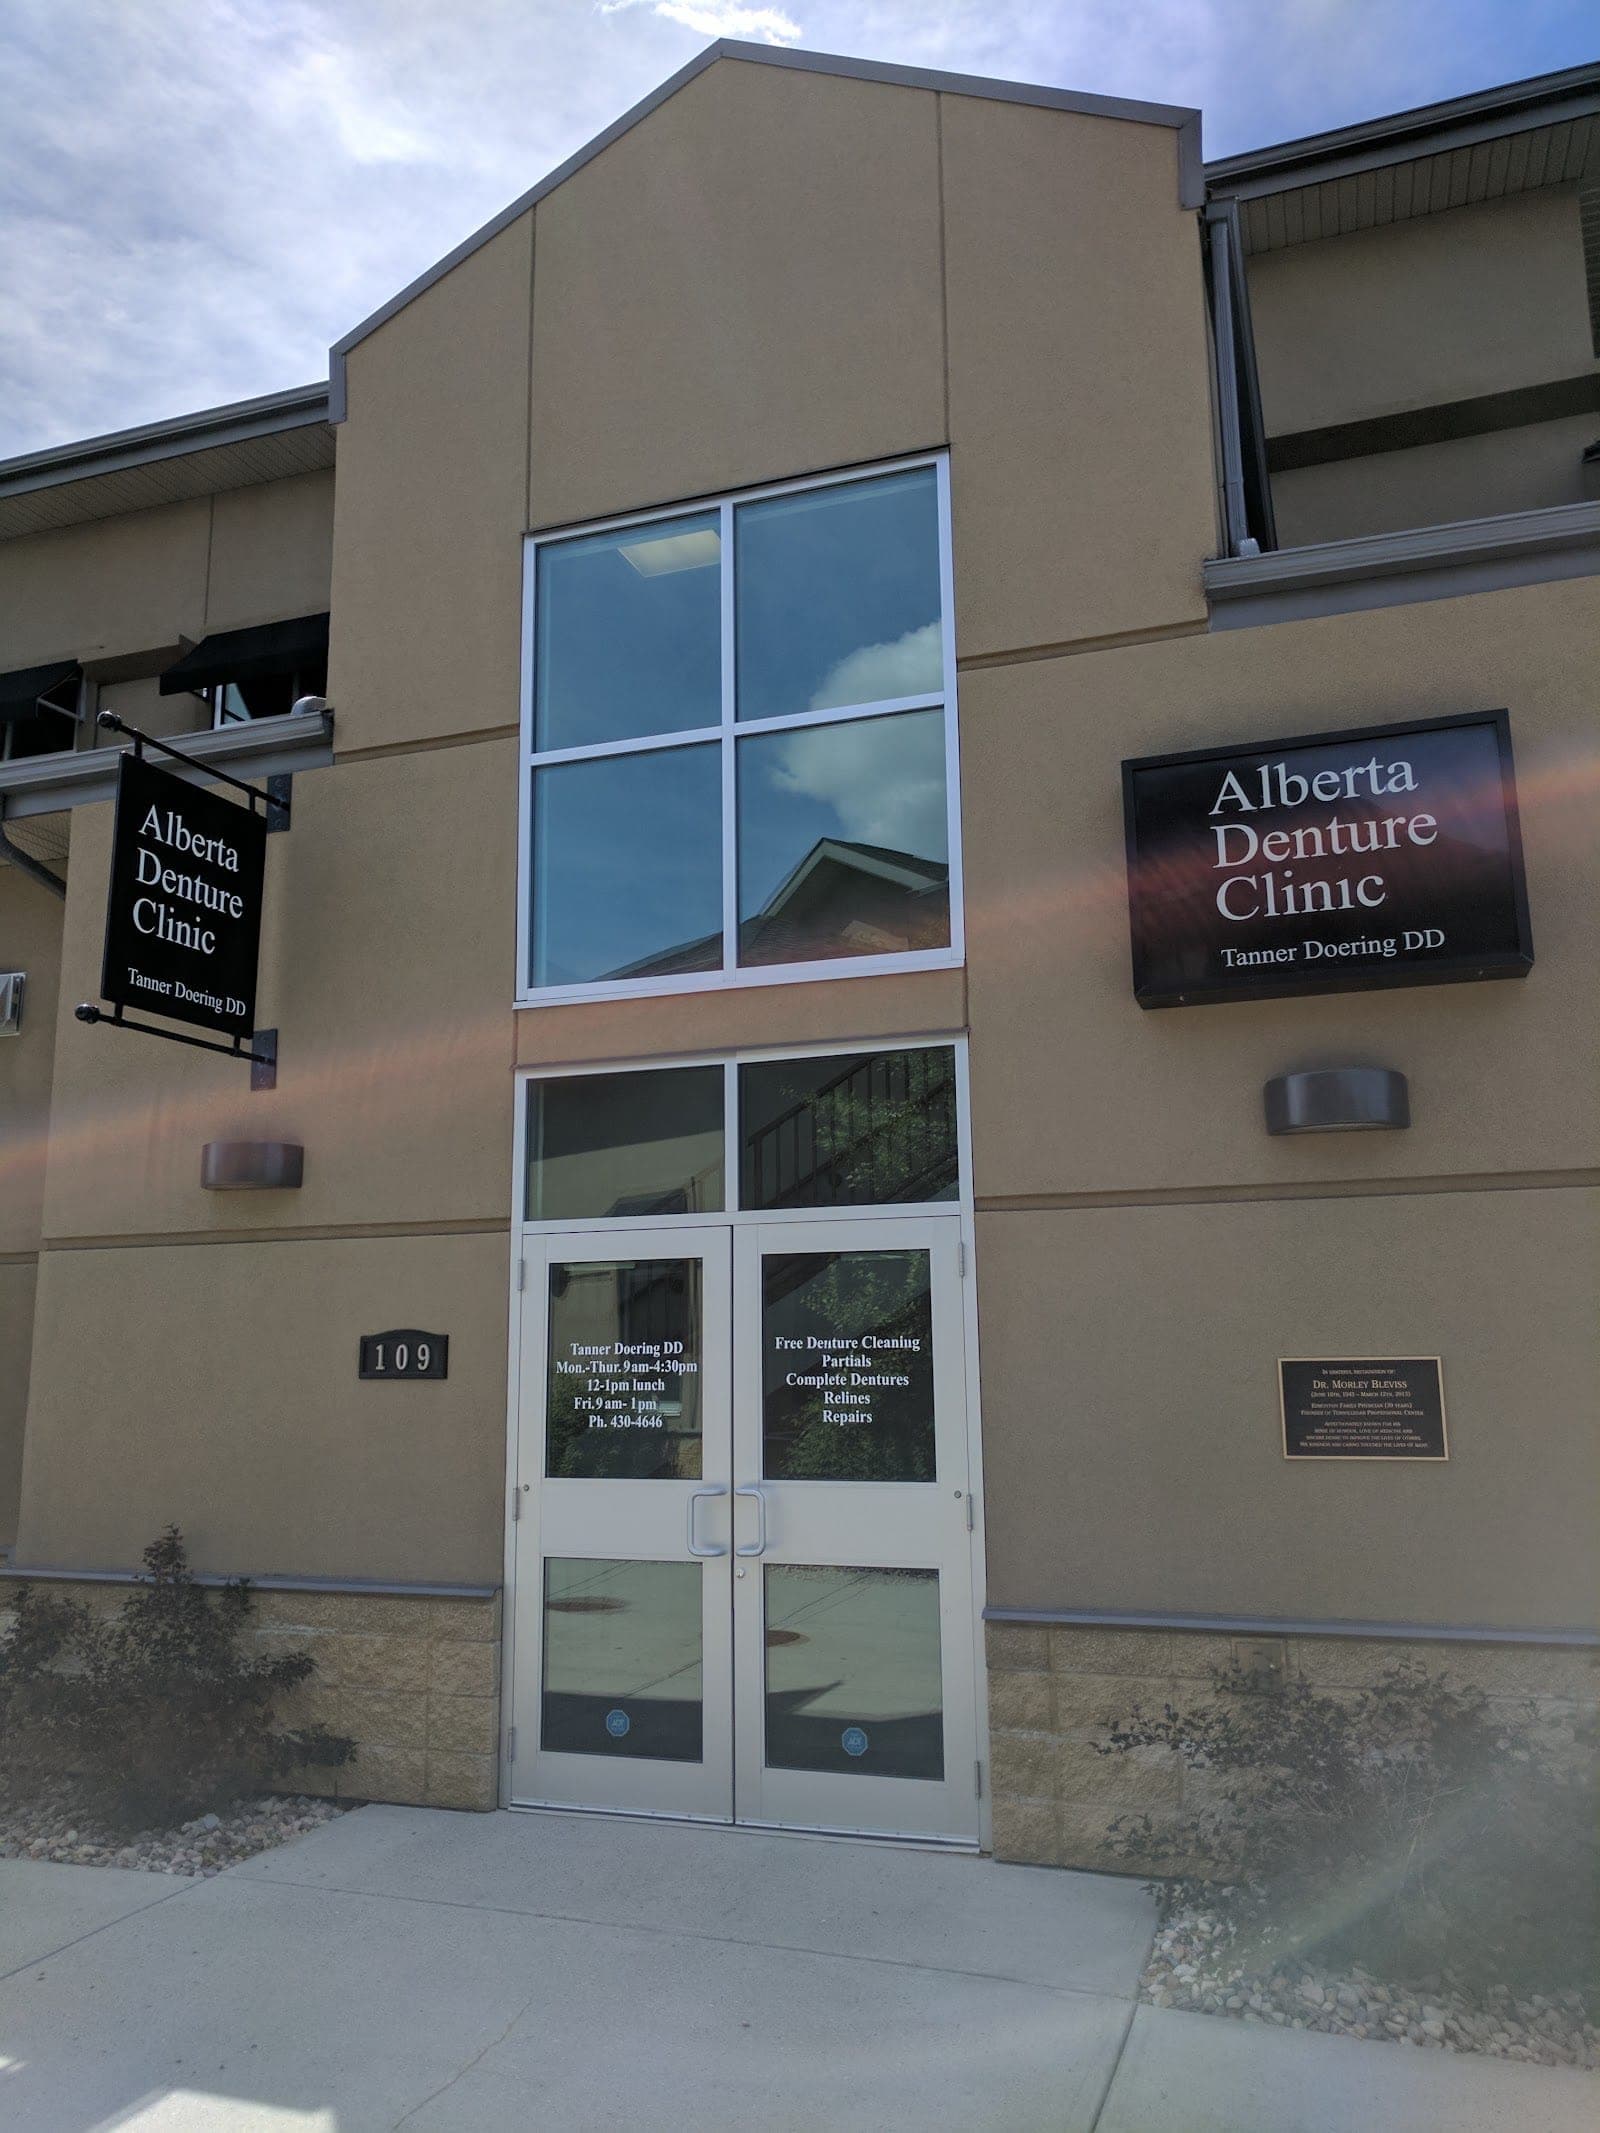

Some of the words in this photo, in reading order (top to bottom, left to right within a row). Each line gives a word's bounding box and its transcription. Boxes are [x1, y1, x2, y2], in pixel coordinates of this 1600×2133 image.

[1208, 757, 1419, 815] Alberta
[139, 804, 239, 872] Alberta
[1210, 811, 1438, 869] Denture
[135, 848, 243, 918] Denture
[1216, 870, 1386, 921] Clinic
[133, 898, 216, 954] Clinic
[1220, 945, 1299, 967] Tanner
[1304, 934, 1396, 960] Doering
[1403, 929, 1445, 951] DD
[127, 967, 172, 995] Tanner
[175, 982, 223, 1013] Doering
[225, 997, 246, 1016] DD
[570, 1343, 611, 1356] Tanner
[614, 1342, 660, 1357] Doering
[663, 1341, 683, 1354] DD
[775, 1336, 803, 1349] Free
[807, 1336, 858, 1349] Denture
[861, 1336, 920, 1351] Cleaning
[375, 1343, 430, 1370] 109
[822, 1354, 872, 1367] Partials
[556, 1361, 622, 1374] Mon.-Thur.
[587, 1379, 629, 1394] 12-1pm
[633, 1379, 665, 1391] lunch
[786, 1373, 847, 1388] Complete
[851, 1373, 909, 1386] Dentures
[824, 1391, 871, 1404] Relines
[589, 1415, 607, 1428] Ph.
[610, 1415, 663, 1428] 430-4646
[823, 1410, 873, 1426] Repairs
